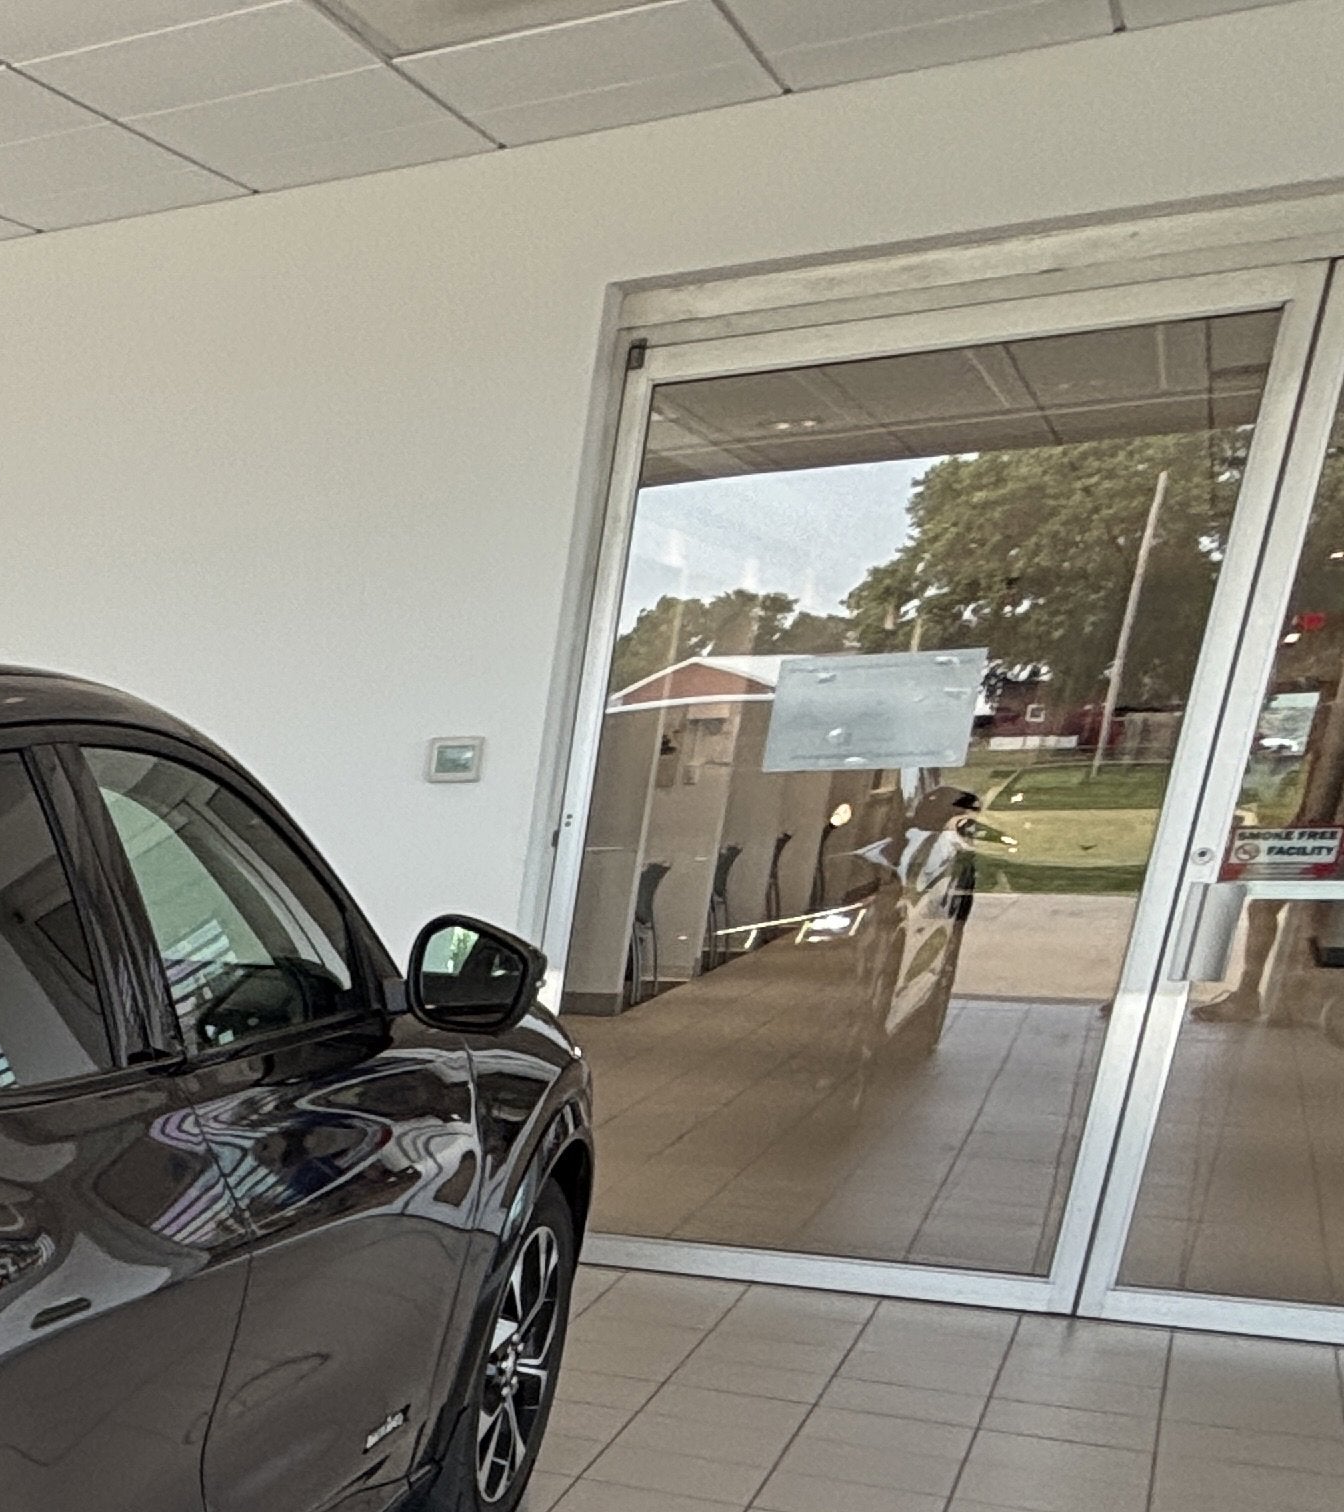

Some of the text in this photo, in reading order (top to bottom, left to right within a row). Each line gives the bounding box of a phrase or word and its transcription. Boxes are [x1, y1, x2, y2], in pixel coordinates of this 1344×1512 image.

[1238, 830, 1339, 841] SMOKE FREE
[1266, 845, 1334, 856] FACILITY
